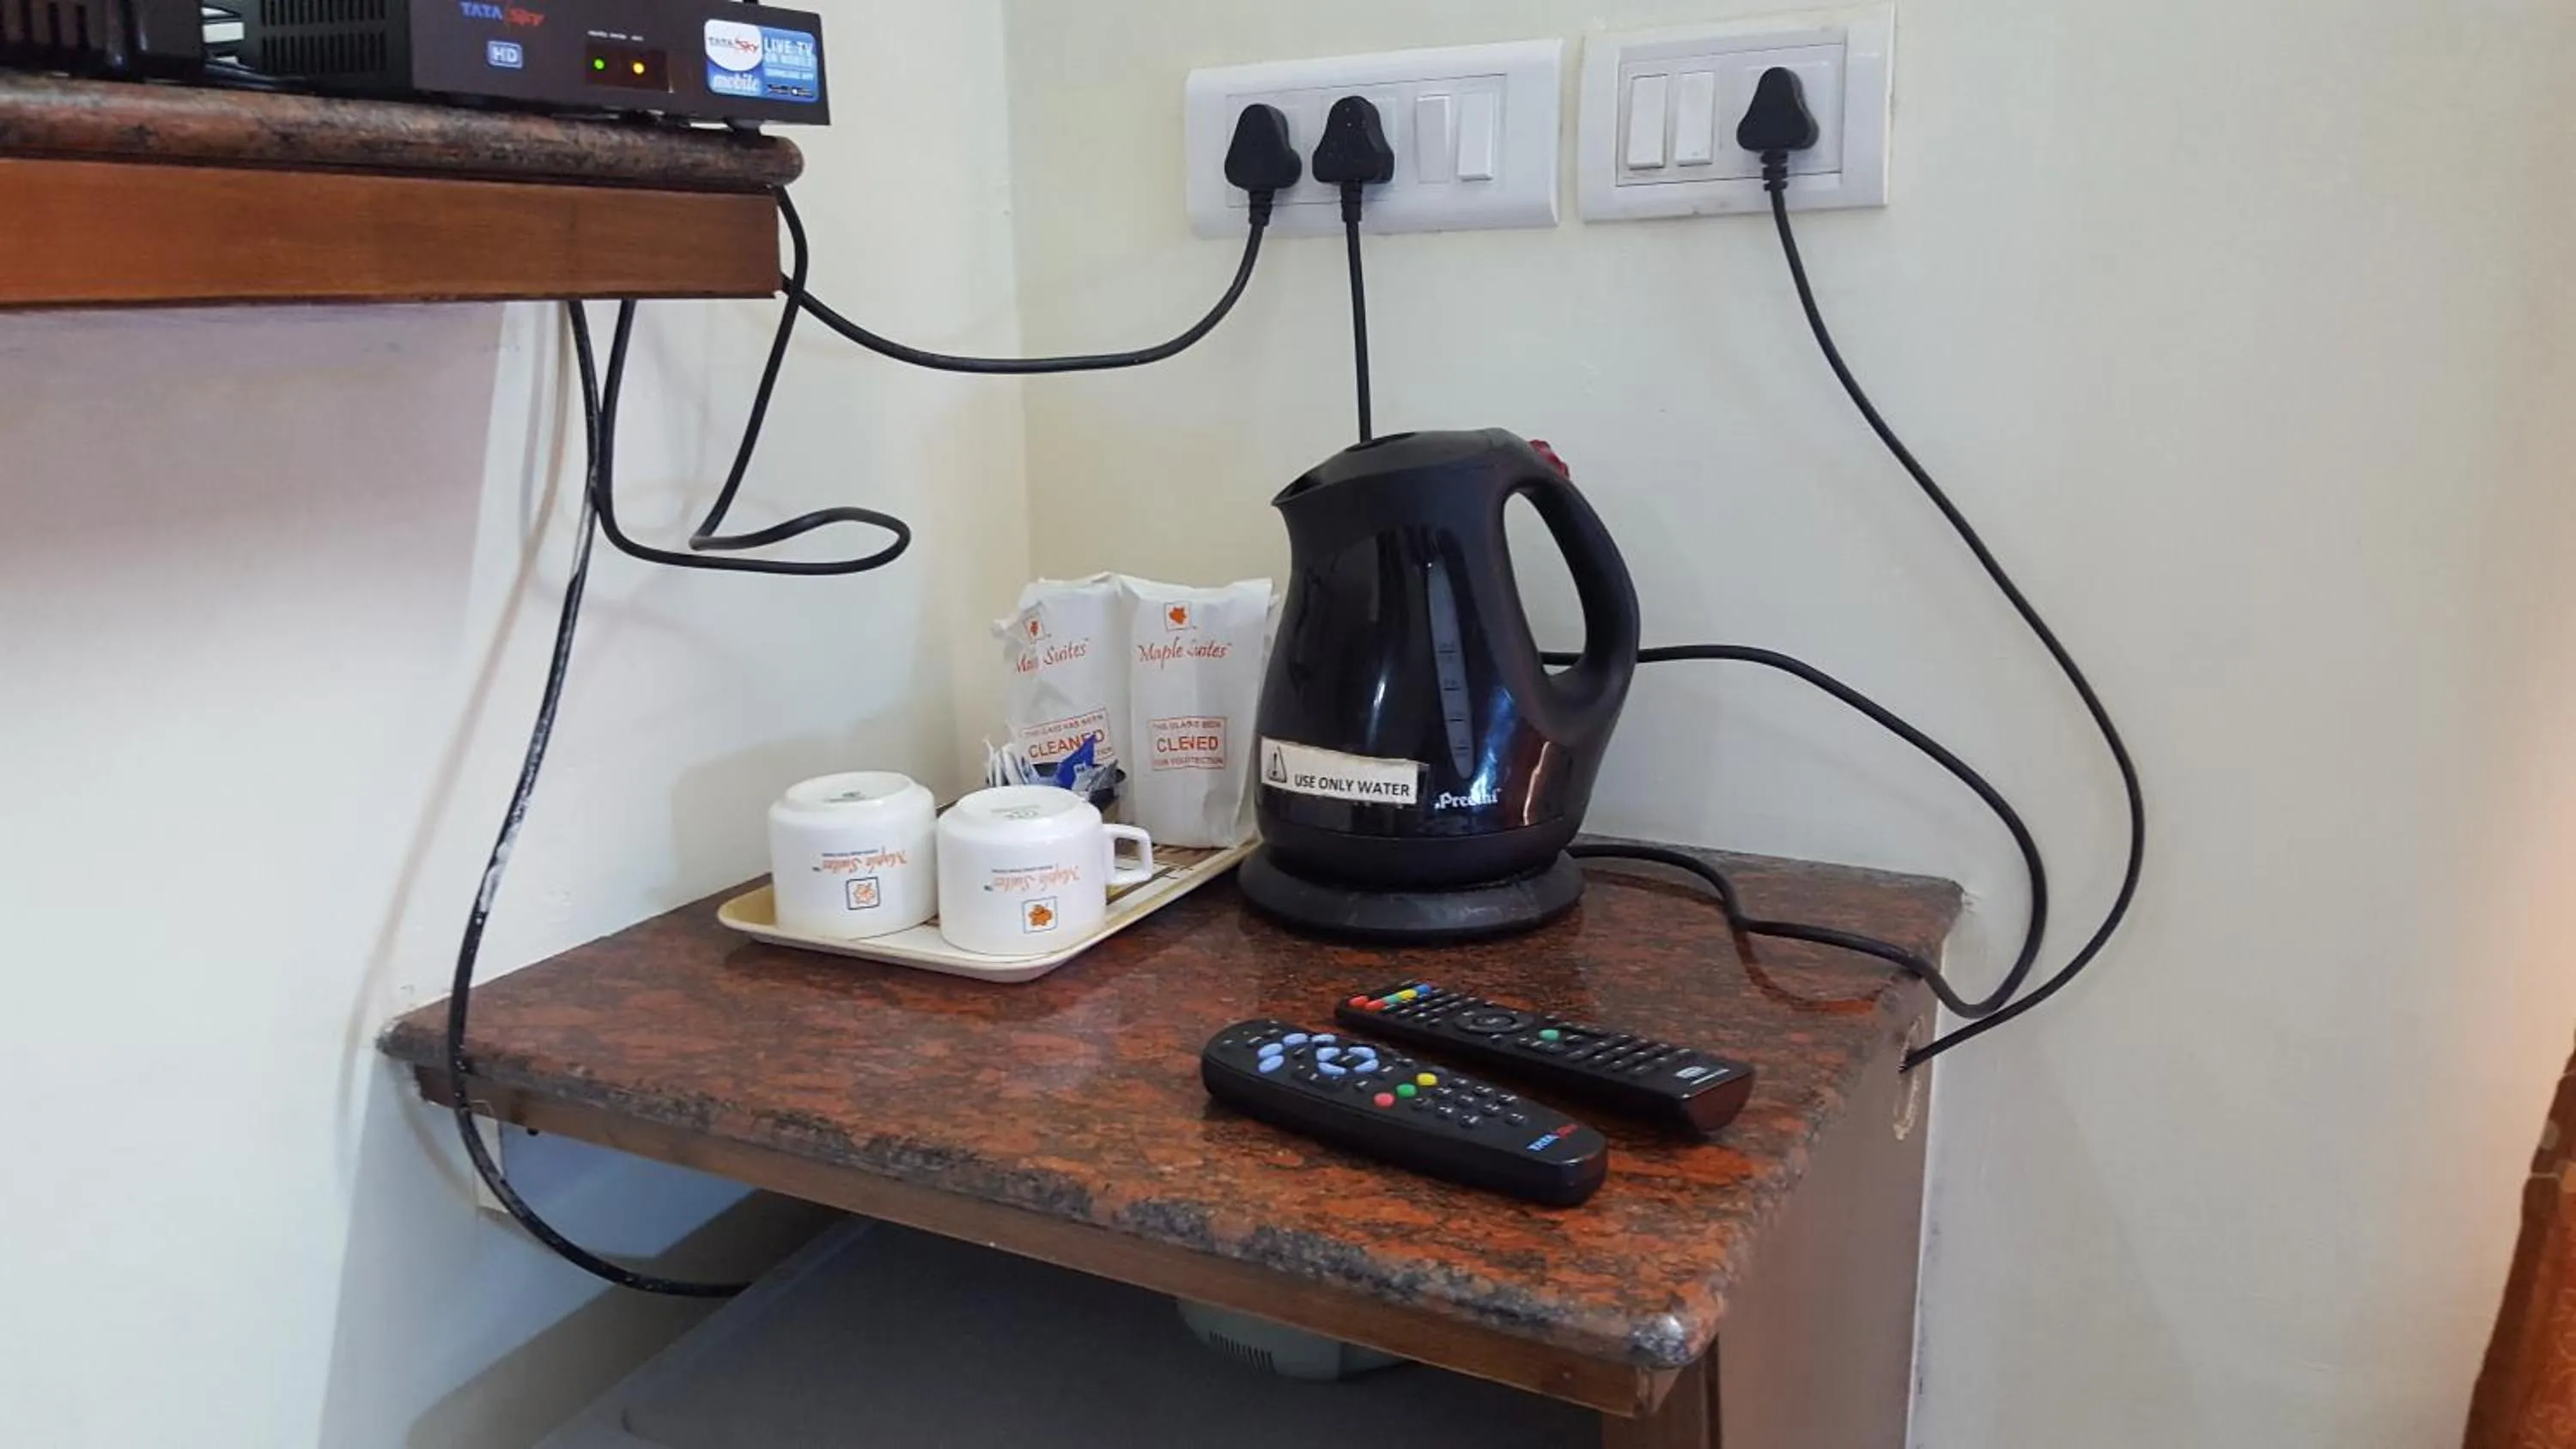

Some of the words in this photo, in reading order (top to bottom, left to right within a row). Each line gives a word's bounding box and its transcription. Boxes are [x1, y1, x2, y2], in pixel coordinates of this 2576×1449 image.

[459, 2, 503, 21] TATA
[492, 45, 519, 64] HD
[714, 73, 760, 92] mobile
[1137, 636, 1183, 670] Maple
[1294, 774, 1315, 788] USE
[1318, 777, 1354, 792] ONLY
[1357, 780, 1411, 797] WATER
[1437, 787, 1498, 809] Preehi
